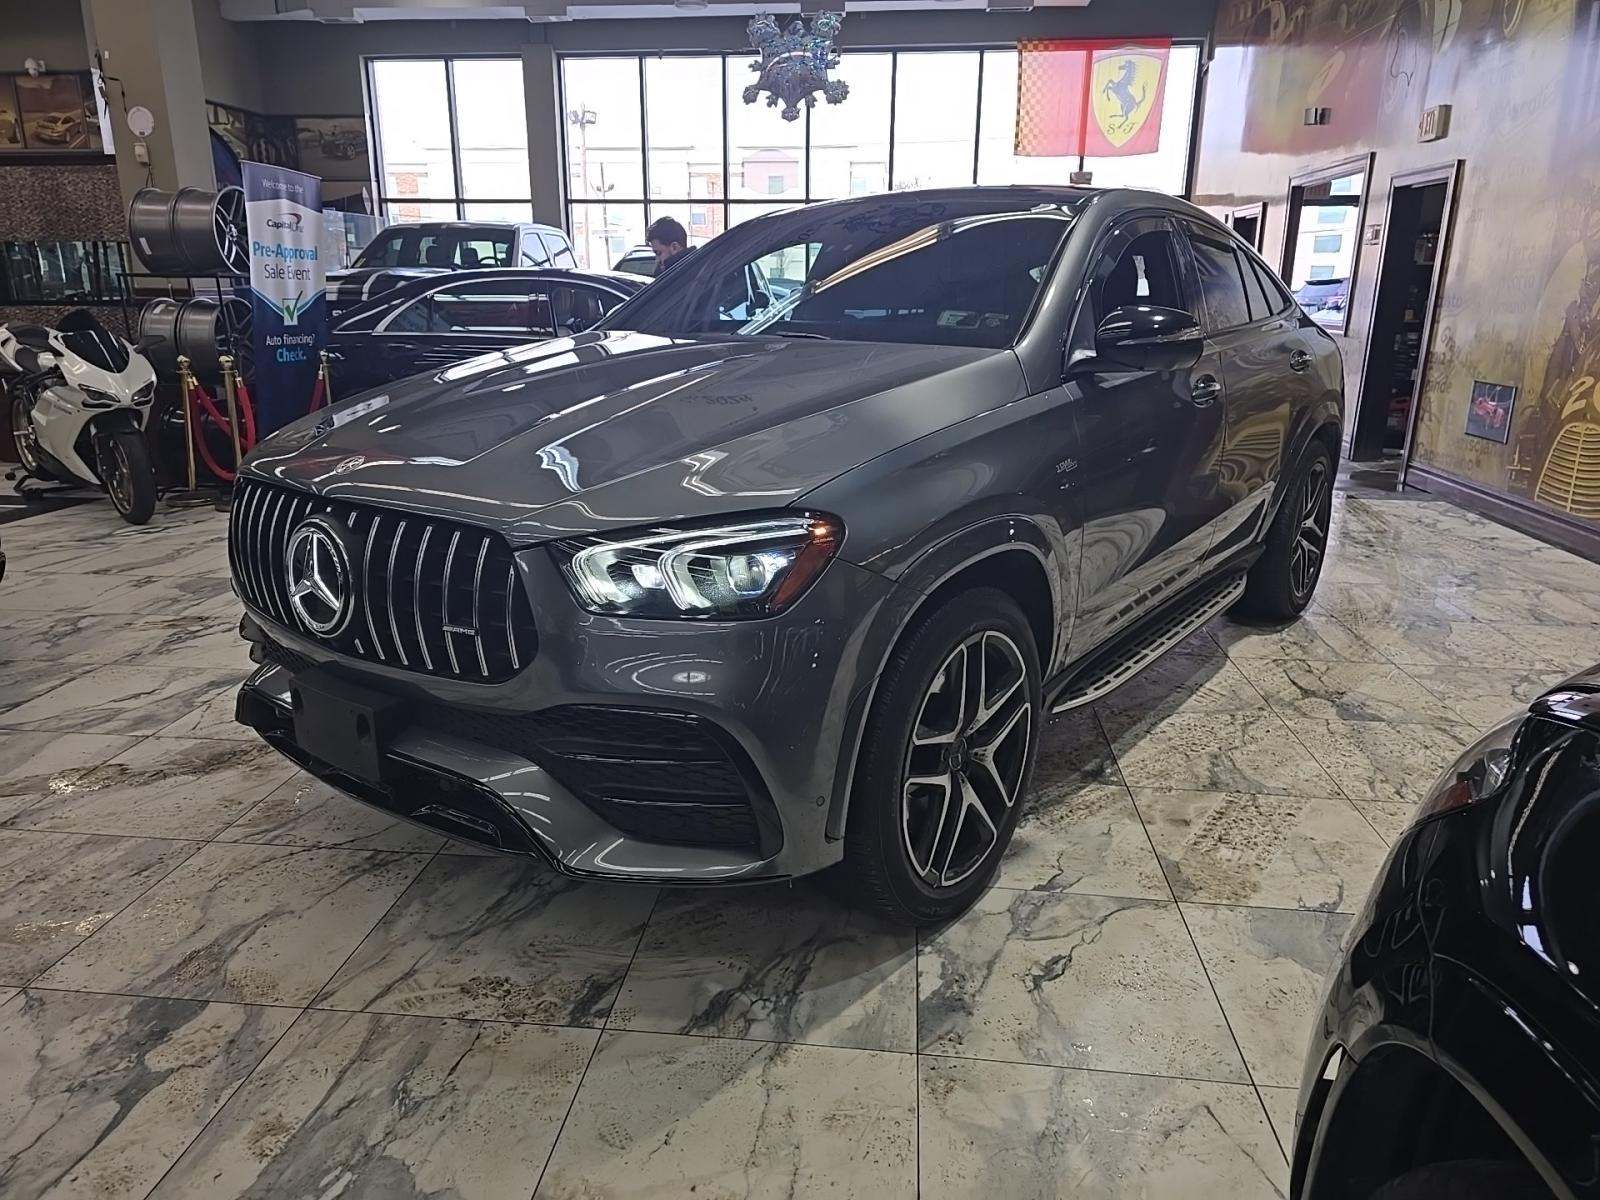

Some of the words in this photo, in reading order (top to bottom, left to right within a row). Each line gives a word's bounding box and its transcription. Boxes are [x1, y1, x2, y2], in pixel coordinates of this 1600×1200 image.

[262, 178, 287, 192] Welcome
[288, 183, 294, 192] to
[295, 183, 304, 193] the
[253, 240, 318, 261] Pre-Approval
[264, 264, 285, 279] Sale
[287, 266, 311, 281] Event
[266, 334, 282, 346] Auto
[283, 333, 316, 347] financing?
[276, 349, 307, 363] Check.
